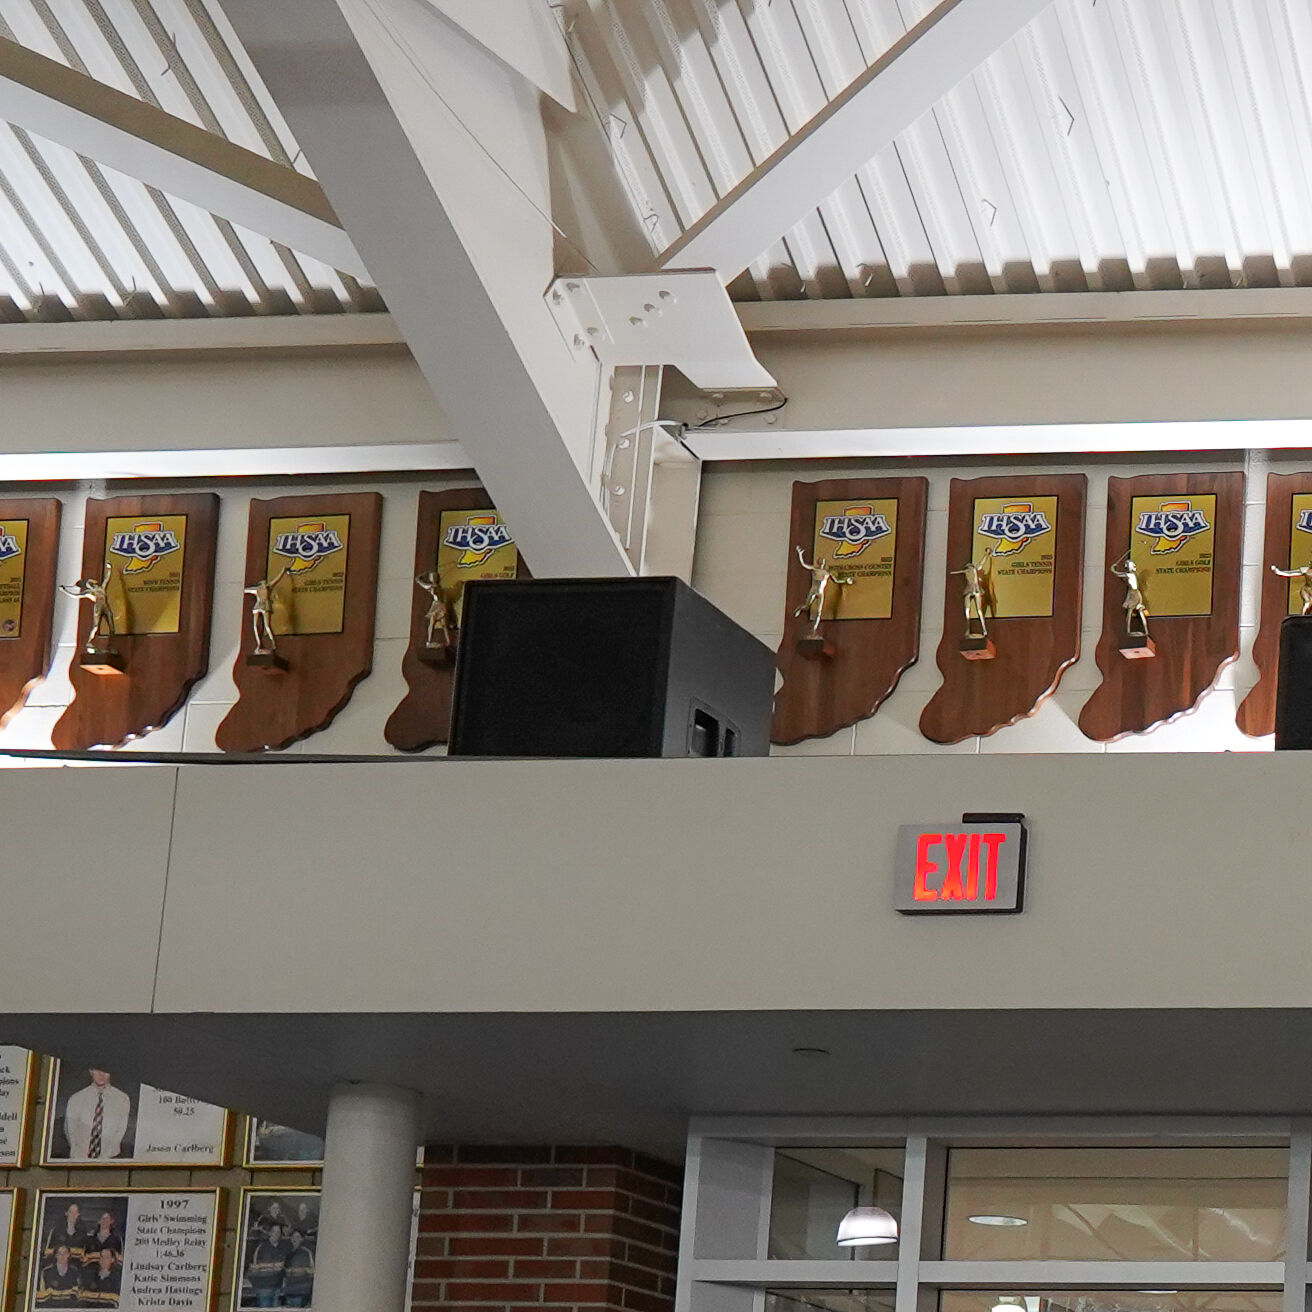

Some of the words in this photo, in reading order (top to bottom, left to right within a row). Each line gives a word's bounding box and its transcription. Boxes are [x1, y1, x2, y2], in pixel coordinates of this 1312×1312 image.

[823, 514, 888, 540] IHSAA
[980, 512, 1048, 539] IHSAA
[1140, 510, 1205, 536] IHSAA
[113, 530, 176, 555] IHSAA
[276, 531, 341, 556] IHSAA
[446, 525, 512, 550] IHSAA
[914, 833, 1007, 901] EXIT
[160, 1199, 190, 1209] 1997
[160, 1226, 207, 1236] Champions
